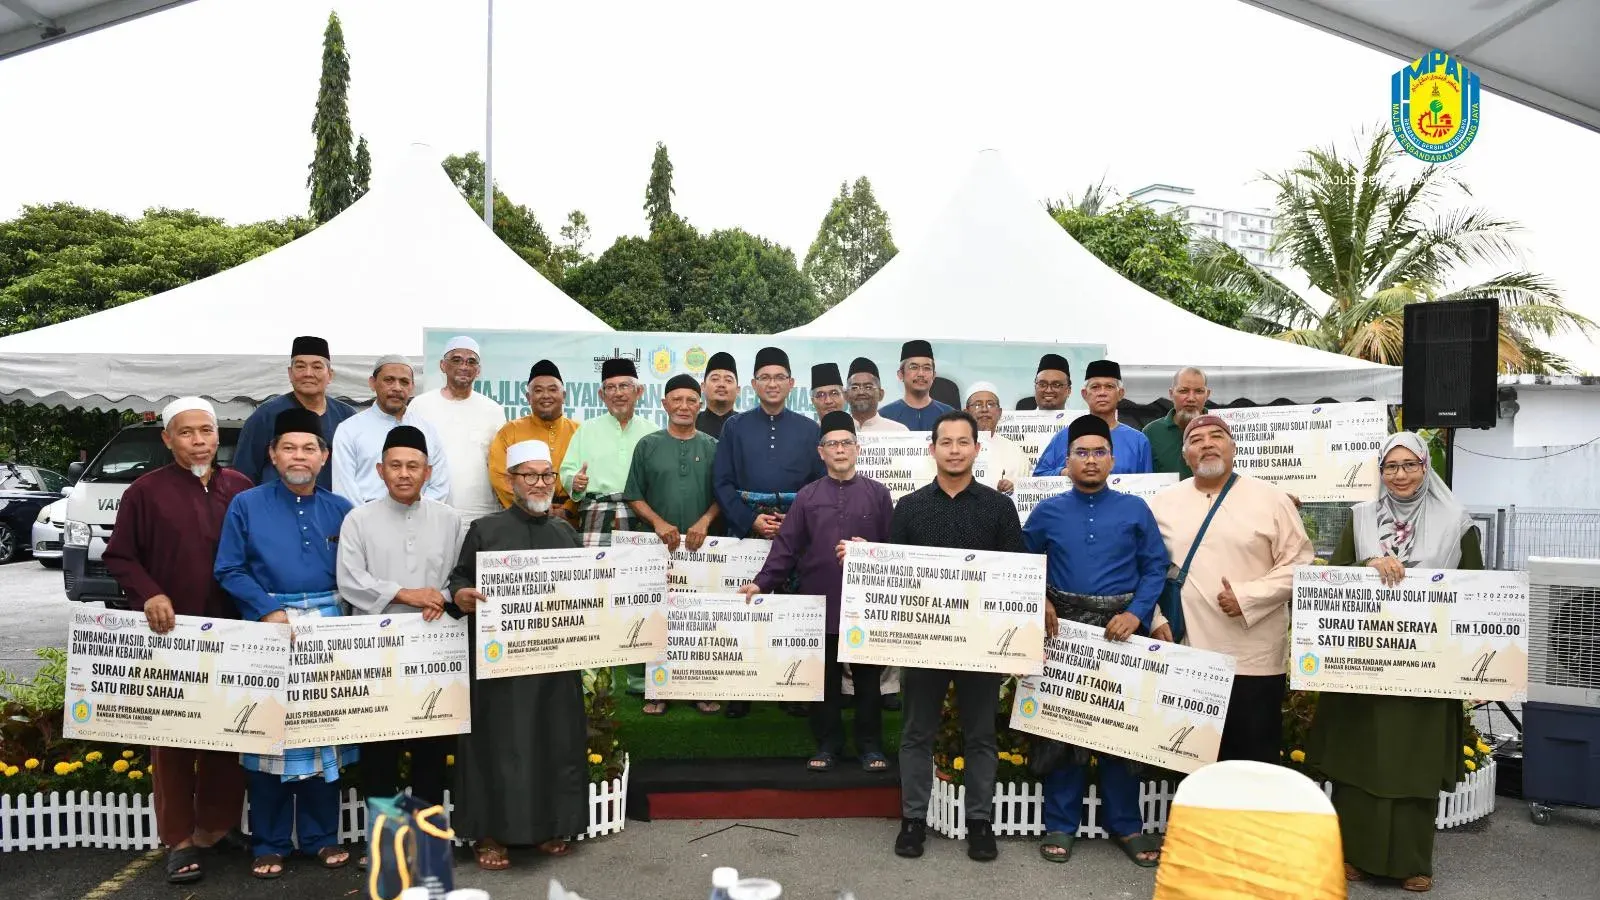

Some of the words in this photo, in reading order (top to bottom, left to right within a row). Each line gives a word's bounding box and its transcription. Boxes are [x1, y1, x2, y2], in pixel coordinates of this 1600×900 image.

[474, 380, 529, 406] AJLIS
[1270, 423, 1289, 432] SURAU
[1290, 422, 1308, 431] SOLAT
[1309, 420, 1332, 430] JUMAAT
[1245, 432, 1275, 442] KEBAJIKAN
[1234, 446, 1255, 456] URAU
[1257, 445, 1294, 455] UBUDIAH
[1331, 443, 1343, 451] RM
[1344, 442, 1381, 451] 1,000.00
[1233, 459, 1248, 468] ATU
[1250, 459, 1269, 468] RIBU
[1271, 458, 1302, 467] SAHAJA
[857, 470, 874, 478] RAU
[875, 470, 912, 479] EHSANIAH
[889, 483, 915, 491] SAHAJA
[689, 552, 705, 562] SOLAT
[706, 553, 727, 563] JUMAAT
[481, 571, 523, 585] SUMBANGAN
[550, 569, 571, 581] SURAU
[573, 569, 592, 580] SOLAT
[593, 568, 616, 580] JUMAAT
[847, 562, 888, 575] SUMBANGAN
[917, 567, 938, 579] SURAU
[940, 569, 960, 580] SOLAT
[961, 570, 986, 582] JUMAAT
[725, 579, 735, 587] RM
[847, 574, 859, 585] DAN
[862, 575, 885, 586] RUMAH
[887, 577, 921, 589] KEBAJIKAN
[481, 585, 495, 597] DAN
[496, 585, 520, 596] RUMAH
[522, 583, 556, 595] KEBAJIKAN
[1297, 586, 1343, 599] SUMBANGAN
[1346, 588, 1373, 601] MASJID,
[1375, 589, 1400, 602] SURAU
[1403, 590, 1426, 602] SOLAT
[1428, 591, 1457, 603] JUMAAT
[614, 596, 625, 605] RM
[628, 593, 662, 604] 1,000.00
[865, 593, 897, 605] SURAU
[900, 595, 929, 607] YUSOF
[932, 597, 969, 610] AL-AMIN
[1297, 599, 1312, 611] DAN
[1314, 600, 1340, 612] RUMAH
[1342, 601, 1381, 613] KEBAJIKAN
[501, 602, 532, 615] SURAU
[534, 598, 604, 612] AL-MUTMAINNAH
[984, 601, 996, 610] RM
[999, 602, 1038, 613] 1,000.00
[501, 619, 525, 631] SATU
[528, 618, 549, 629] RIBU
[552, 615, 585, 627] SAHAJA
[712, 612, 732, 621] SURAU
[733, 612, 751, 621] SOLAT
[751, 612, 773, 622] JUMAAT
[864, 609, 888, 620] SATU
[891, 611, 913, 622] RIBU
[915, 612, 951, 625] SAHAJA
[686, 622, 717, 632] KEBAJIKAN
[1318, 618, 1355, 630] SURAU
[1357, 620, 1394, 632] TAMAN
[1397, 621, 1438, 634] SERAYA
[1456, 624, 1469, 633] RM
[1473, 624, 1520, 635] 1,000.00
[73, 630, 117, 645] SUMBANGAN
[119, 634, 146, 648] MASJID,
[148, 636, 171, 649] SURAU
[173, 638, 195, 651] SOLAT
[196, 640, 224, 653] JUMAAT
[297, 640, 326, 652] MASJID,
[327, 639, 352, 651] SURAU
[354, 637, 375, 650] SOLAT
[377, 636, 404, 648] JUMAAT
[667, 637, 695, 646] SURAU
[697, 637, 739, 647] AT-TAQWA
[772, 639, 783, 647] RM
[785, 638, 819, 647] 1,000.00
[1318, 635, 1345, 647] SATU
[1348, 636, 1373, 648] RIBU
[1376, 637, 1417, 650] SAHAJA
[73, 643, 86, 655] DAN
[88, 644, 113, 657] RUMAH
[115, 647, 153, 660] KEBAJIKAN
[295, 652, 333, 665] KEBAJIKAN
[667, 651, 688, 661] SATU
[690, 651, 710, 661] RIBU
[712, 652, 743, 661] SAHAJA
[1044, 636, 1069, 651] BANGAN
[1071, 643, 1095, 658] MASJID,
[1097, 648, 1120, 663] SURAU
[1121, 654, 1142, 669] SOLAT
[1142, 659, 1170, 675] JUMAAT
[405, 665, 417, 675] RM
[420, 662, 461, 674] 1,000.00
[1066, 653, 1101, 671] KEBAJIKAN
[1324, 656, 1346, 664] MAJLIS
[1347, 658, 1392, 666] PERBANDARAN
[1392, 660, 1419, 668] AMPANG
[92, 663, 125, 677] SURAU
[128, 666, 141, 679] AR
[143, 667, 209, 684] ARAHMANIAH
[301, 670, 329, 683] TAMAN
[331, 668, 361, 681] PANDAN
[364, 667, 392, 678] MEWAH
[1043, 666, 1074, 683] SURAU
[1076, 674, 1122, 695] AT-TAQWA
[221, 674, 234, 684] RM
[237, 674, 280, 688] 1,000.00
[91, 681, 117, 694] SATU
[120, 684, 144, 696] RIBU
[146, 686, 184, 700] SAHAJA
[303, 688, 327, 700] RIBU
[331, 685, 369, 698] SAHAJA
[1040, 681, 1063, 697] SATU
[1065, 688, 1088, 703] RIBU
[1090, 694, 1125, 712] SAHAJA
[96, 704, 117, 713] MAJLIS
[118, 705, 160, 716] PERBANDARAN
[161, 709, 186, 718] AMPANG
[187, 711, 201, 719] JAYA
[303, 709, 346, 719] PERBANDARAN
[348, 706, 373, 715] AMPANG
[375, 705, 388, 713] JAYA
[1162, 695, 1175, 705] RM
[1177, 697, 1220, 716] 1,000.00
